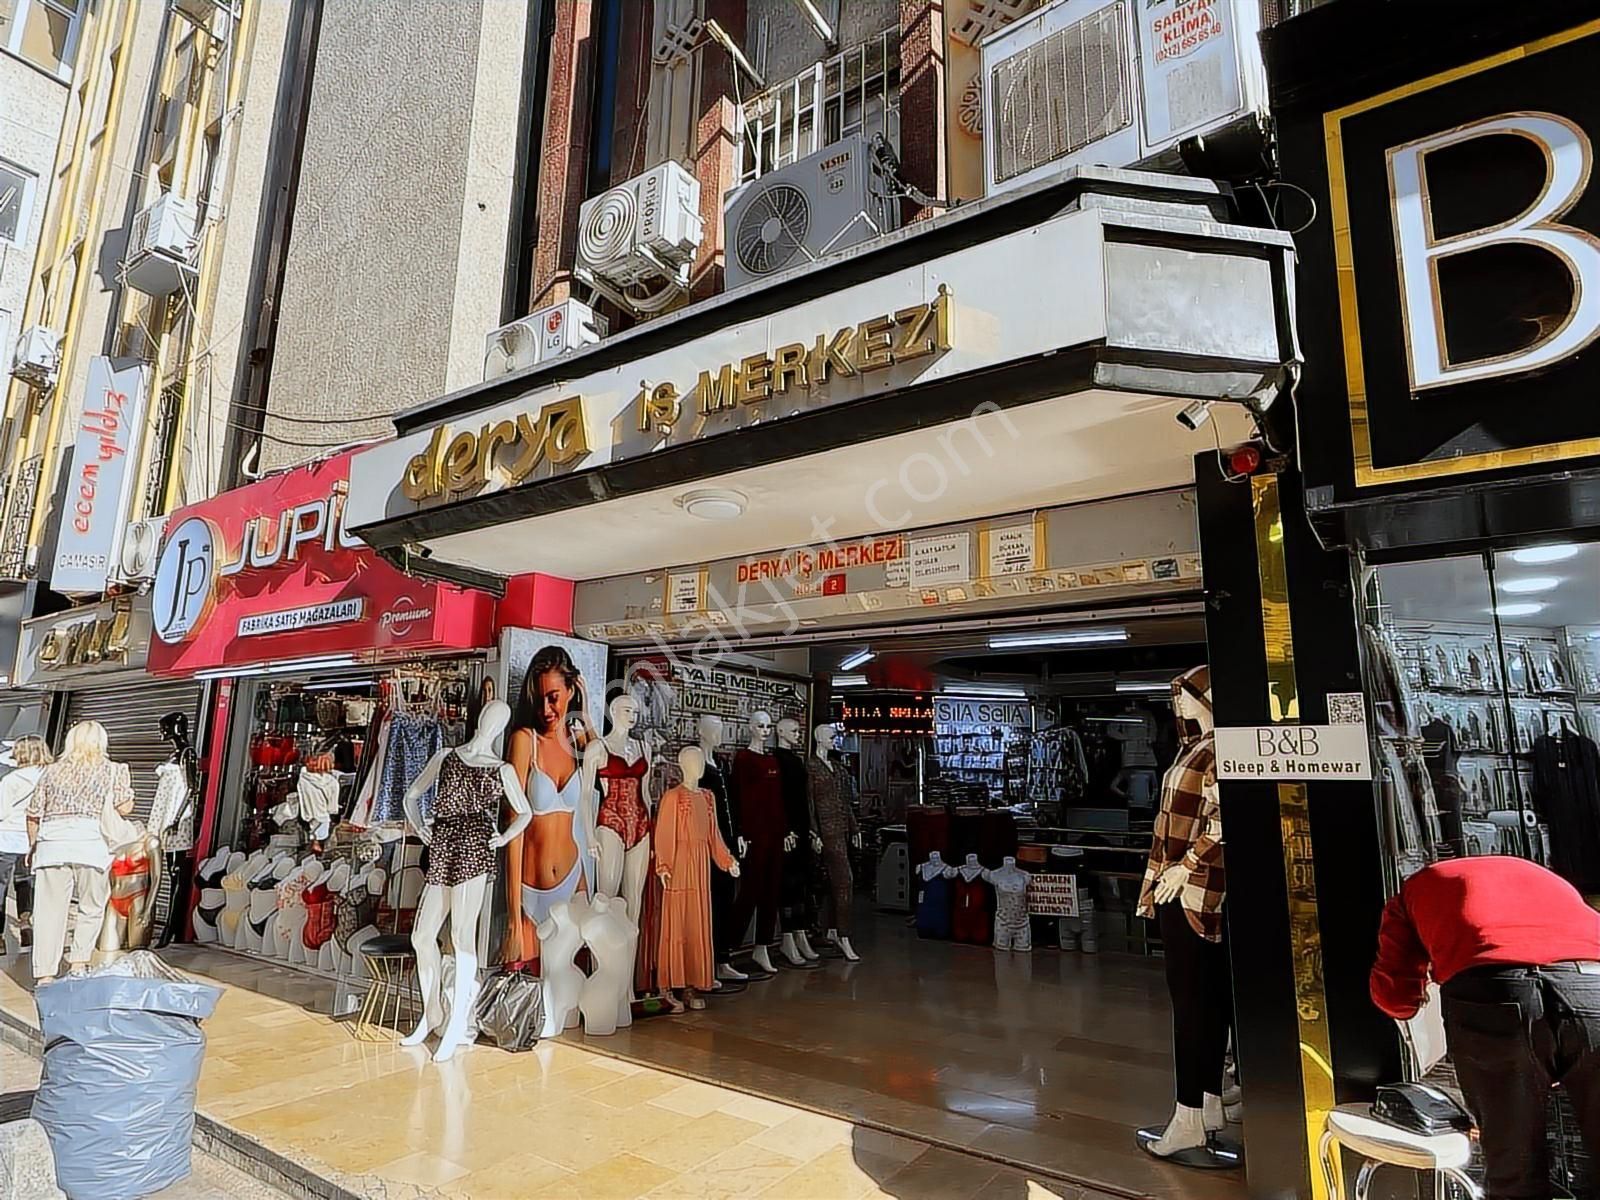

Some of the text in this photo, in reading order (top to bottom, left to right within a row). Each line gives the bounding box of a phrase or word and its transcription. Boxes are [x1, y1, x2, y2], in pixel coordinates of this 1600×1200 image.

[1163, 12, 1211, 44] KLİMA
[1385, 111, 1600, 392] B
[547, 335, 560, 349] LG
[402, 395, 592, 500] derya
[699, 283, 953, 415] MERKEZİ
[737, 559, 790, 583] DERYA
[818, 534, 904, 571] MERKEZİ
[1256, 726, 1320, 757] B&B
[1223, 759, 1361, 776] Sleep & Homewar
